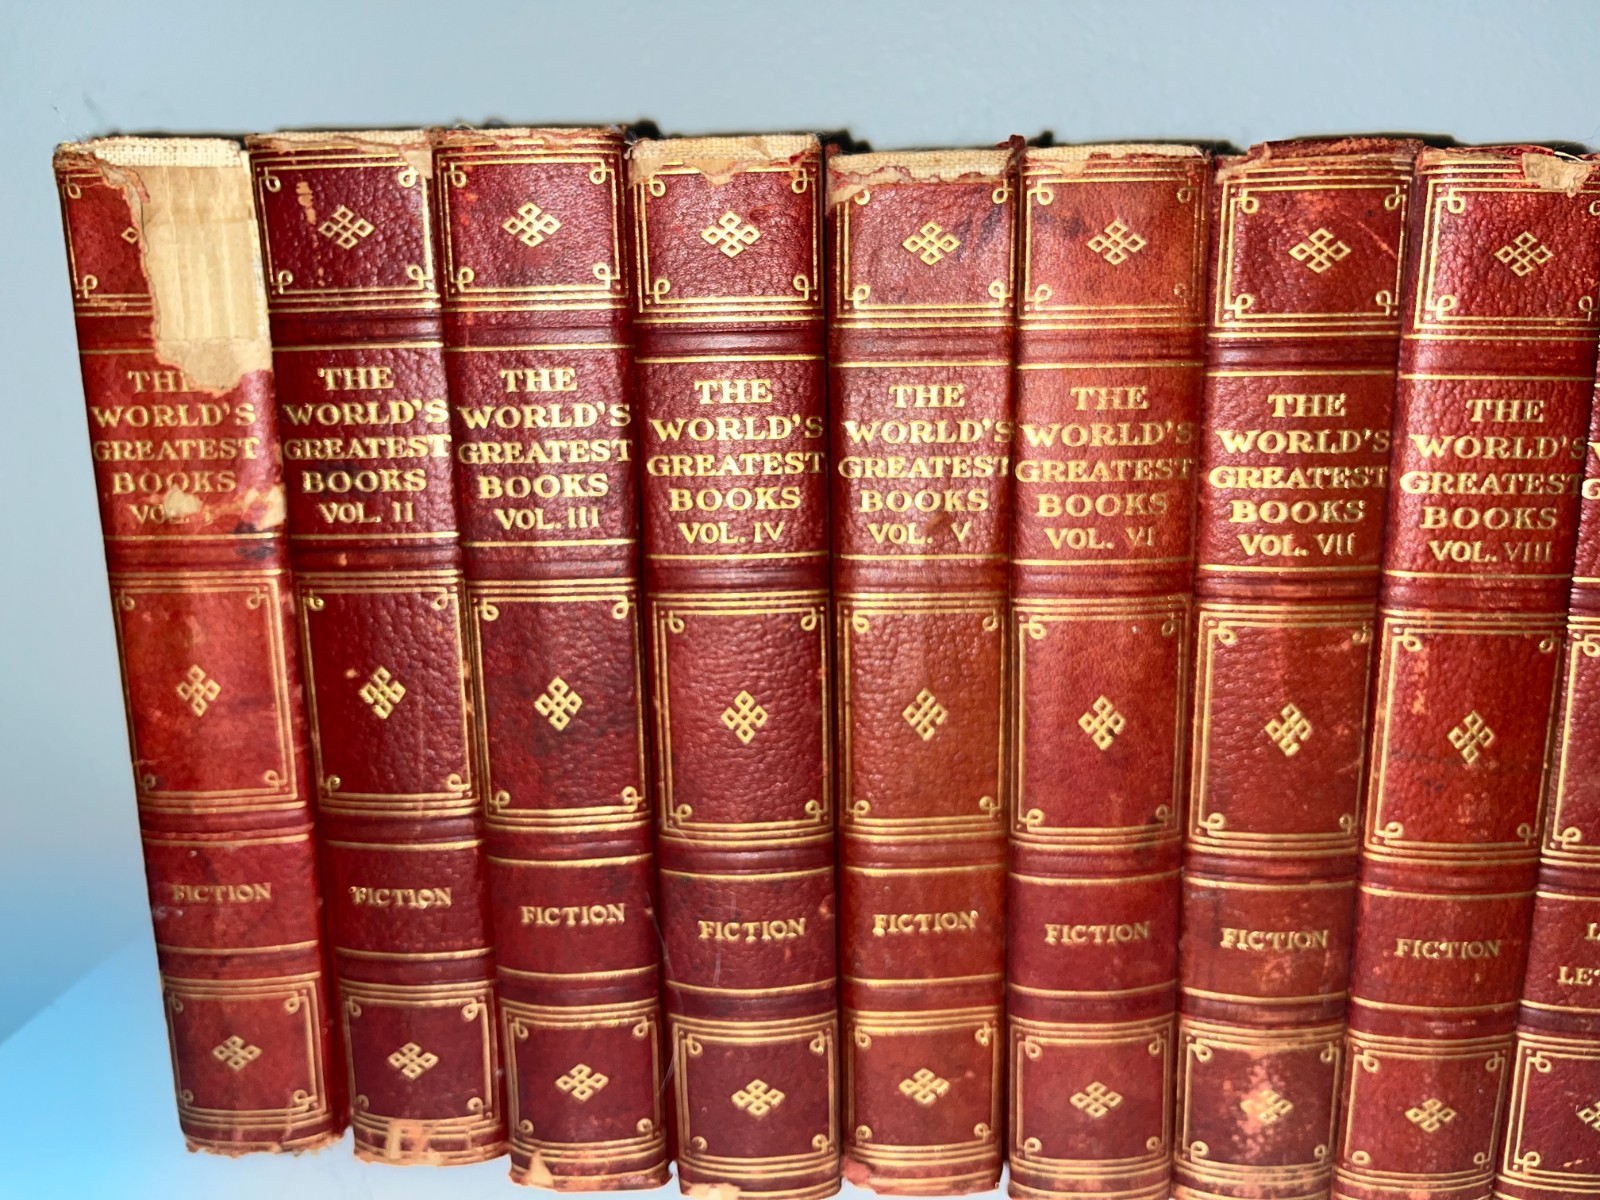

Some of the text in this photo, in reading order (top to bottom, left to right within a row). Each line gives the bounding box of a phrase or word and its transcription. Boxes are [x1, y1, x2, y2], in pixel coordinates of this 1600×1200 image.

[318, 366, 394, 391] THE
[500, 367, 577, 392] THE
[694, 378, 773, 405] THE
[888, 383, 966, 409] THE
[1070, 385, 1149, 411] THE
[90, 402, 257, 428] WORLD'S
[282, 398, 449, 426] WORLD'S
[458, 401, 631, 429] WORLD'S
[1267, 392, 1347, 418] THE
[1465, 398, 1545, 423] THE
[651, 414, 823, 442] WORLD'S
[844, 418, 1013, 444] WORLD'S
[1019, 421, 1195, 448] WORLD'S
[93, 438, 260, 461] GREATEST
[284, 434, 452, 460] GREATEST
[458, 439, 632, 464] GREATEST
[1215, 428, 1390, 454] WORLD'S
[1409, 433, 1587, 460] WORLD'S
[647, 452, 825, 477] GREATEST
[1015, 458, 1194, 484] GREATEST
[112, 470, 236, 495] BOOKS
[301, 469, 427, 493] BOOKS
[478, 473, 609, 499] BOOKS
[1208, 465, 1388, 490] GREATEST
[1400, 472, 1583, 497] GREATEST
[669, 486, 801, 512] BOOKS
[859, 488, 989, 513] BOOKS
[1036, 492, 1168, 518] BOOKS
[319, 501, 413, 524] VOL. II
[494, 506, 599, 530] VOL. III
[1228, 500, 1366, 524] BOOKS
[1420, 506, 1557, 531] BOOKS
[678, 521, 785, 544] VOL. IV
[867, 521, 973, 545] VOL. V
[1044, 526, 1154, 550] VOL. VI
[1236, 532, 1356, 557] VOL. VII
[1428, 540, 1551, 563] VOL. VIII
[171, 882, 272, 905] FICTION
[351, 886, 452, 909] FICTION
[520, 903, 626, 927] FICTION
[872, 910, 978, 937] FICTION
[697, 917, 806, 944] FICTION
[1044, 921, 1150, 946] FICTION
[1219, 927, 1328, 951] FICTION
[1394, 938, 1500, 960] FICTION
